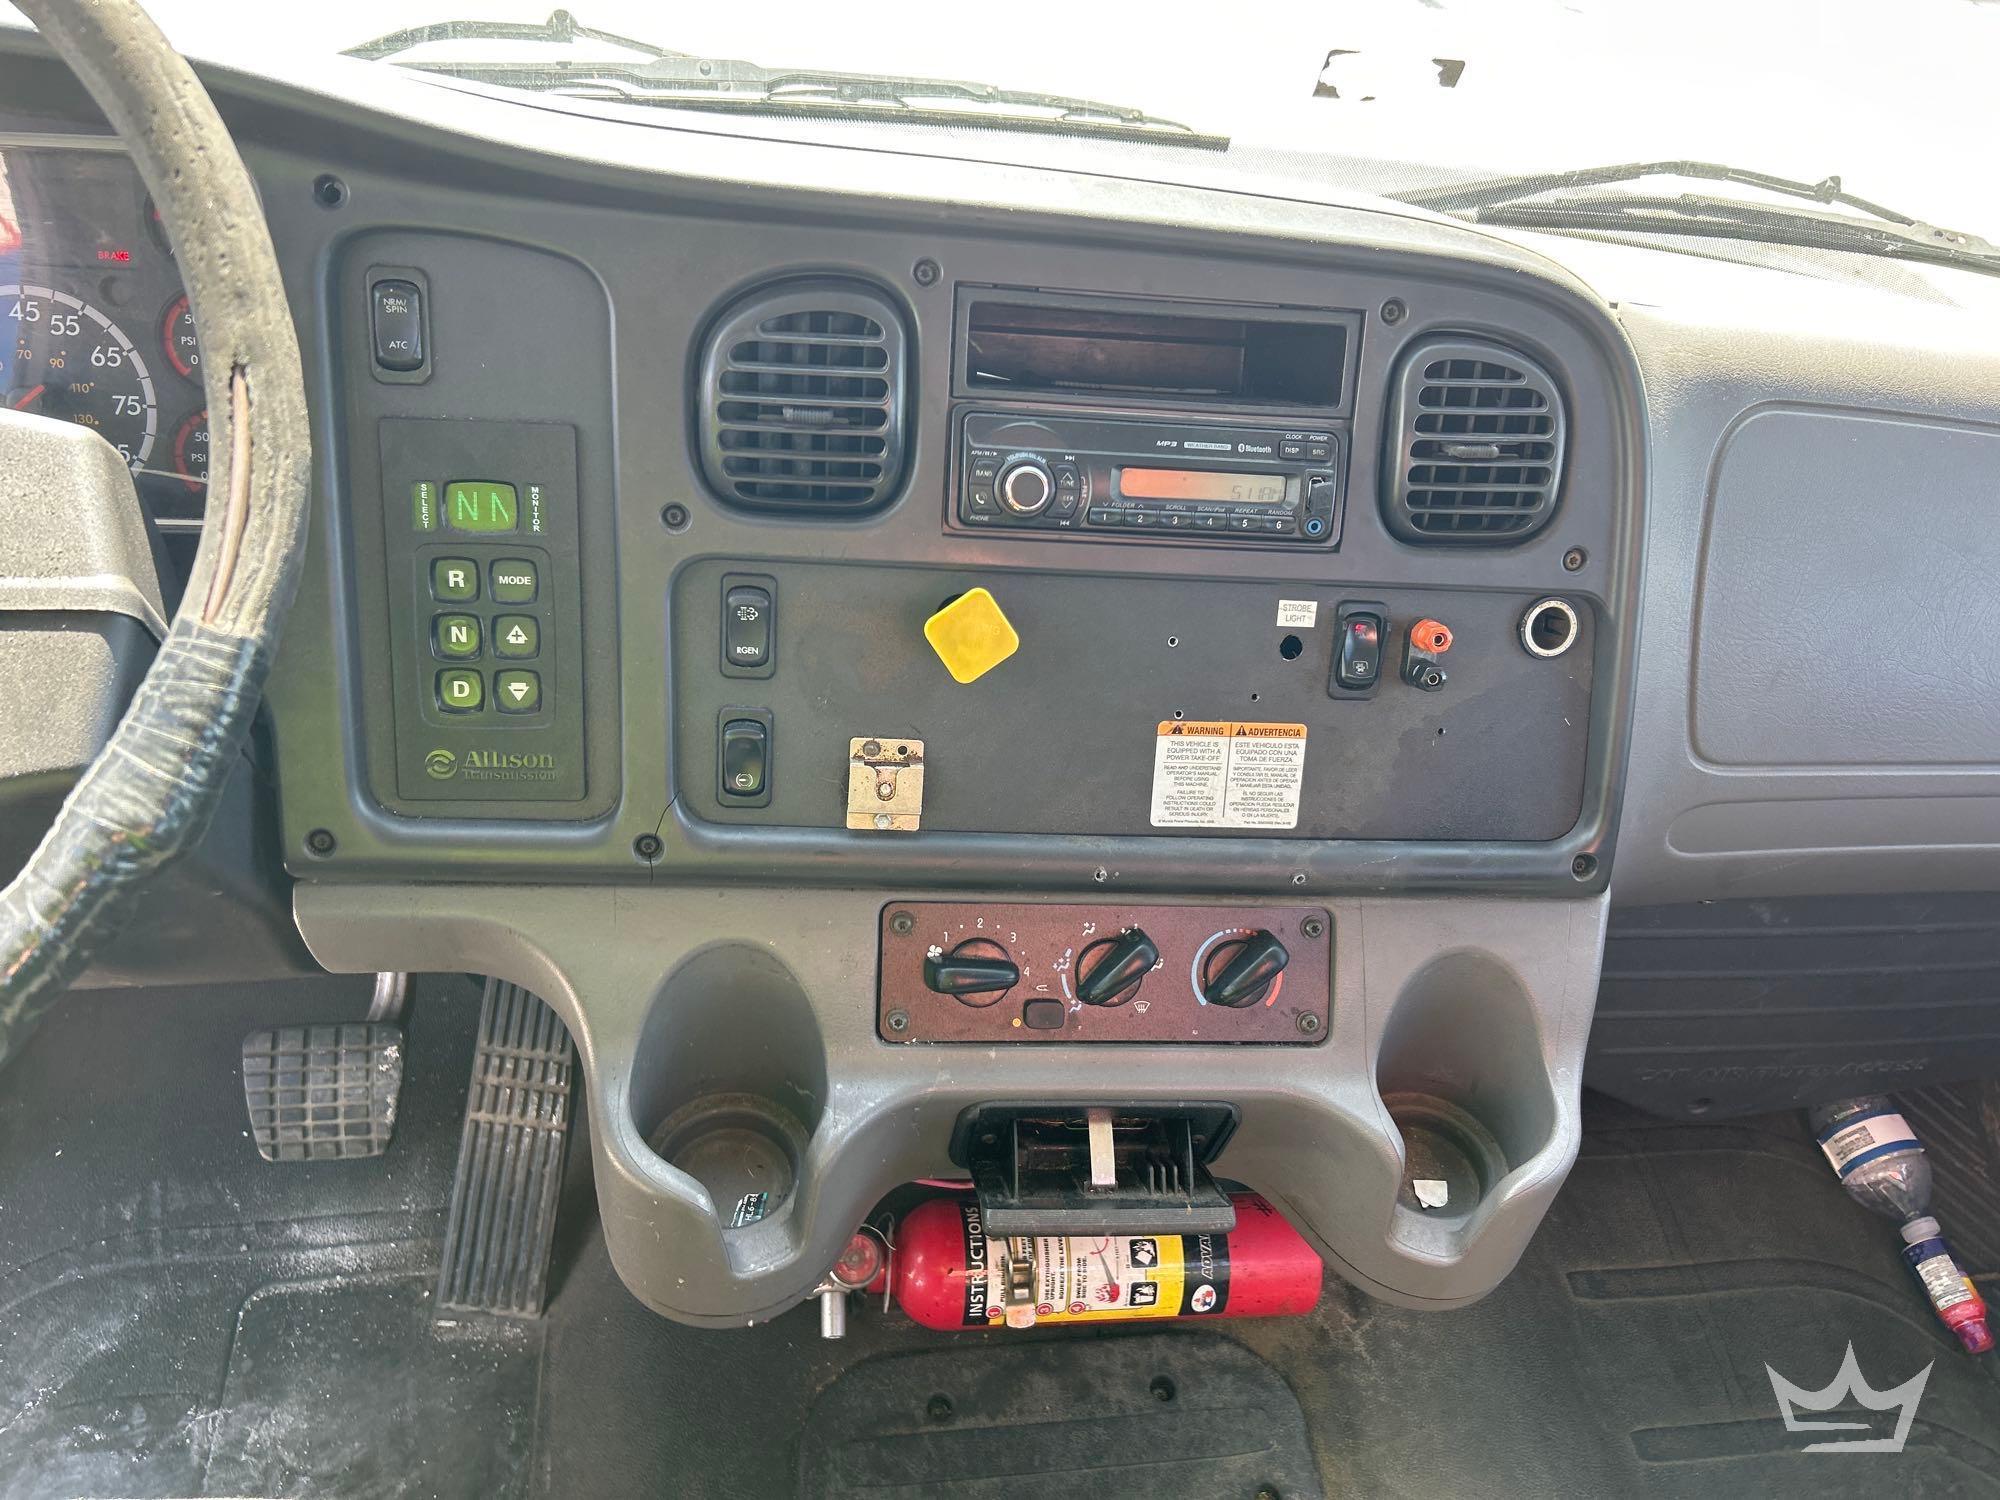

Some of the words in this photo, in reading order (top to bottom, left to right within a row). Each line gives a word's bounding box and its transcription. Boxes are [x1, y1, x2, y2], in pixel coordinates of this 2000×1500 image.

[97, 250, 131, 262] BRAKE
[8, 301, 41, 322] 45
[385, 305, 408, 314] SPIN
[50, 314, 81, 336] 55
[181, 336, 197, 346] PSI
[389, 340, 408, 350] ATC
[16, 349, 33, 360] 70
[90, 345, 122, 368] 65
[49, 358, 65, 369] 90
[70, 383, 90, 394] 110
[111, 395, 141, 416] 75
[73, 414, 93, 424] 130
[1245, 444, 1272, 454] Bluetooth
[191, 454, 207, 463] PSI
[420, 483, 429, 529] SELECT
[457, 490, 478, 521] N
[531, 486, 541, 532] MONITOR
[1137, 514, 1143, 522] 2
[1172, 516, 1178, 524] 3
[1207, 517, 1213, 526] 4
[1242, 518, 1248, 527] 5
[1276, 520, 1282, 529] 6
[448, 569, 465, 588] R
[498, 575, 532, 585] MODE
[1282, 603, 1312, 612] STROBE
[1285, 614, 1306, 623] LIGHT
[451, 626, 468, 643] N
[736, 646, 759, 656] RGEN
[453, 680, 470, 698] D
[1187, 726, 1224, 735] WARNING
[1247, 728, 1301, 736] ADVERTENCIA
[465, 751, 554, 769] Allison
[462, 768, 557, 781] Transmission
[976, 917, 984, 929] 2
[943, 931, 948, 943] 1
[1010, 931, 1017, 943] 3
[1023, 966, 1030, 977] 4
[965, 1206, 988, 1317] INSTRUCTIONS
